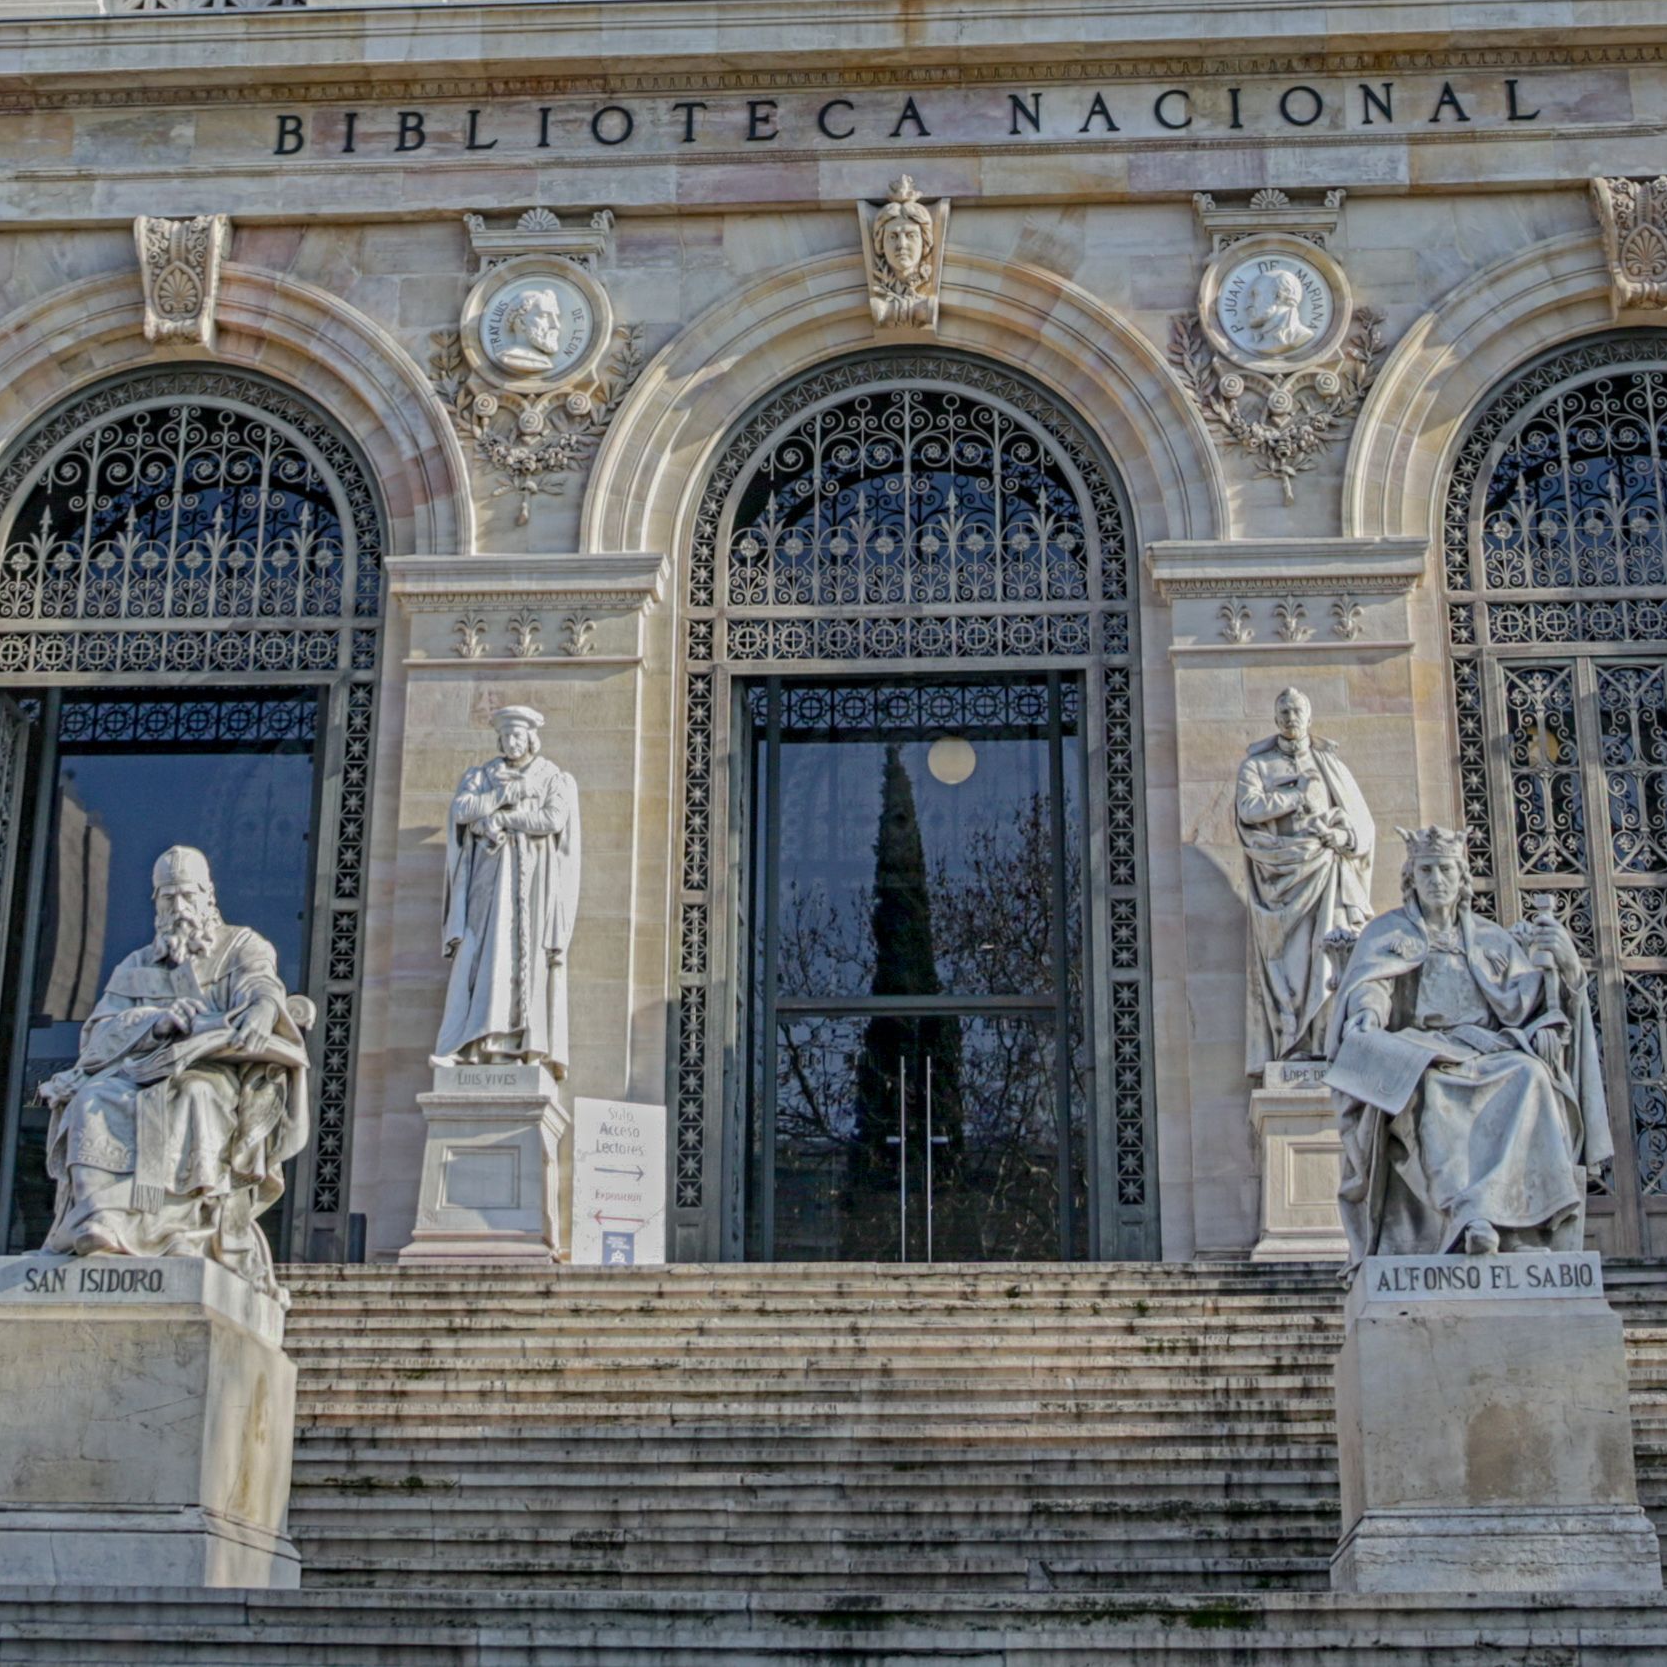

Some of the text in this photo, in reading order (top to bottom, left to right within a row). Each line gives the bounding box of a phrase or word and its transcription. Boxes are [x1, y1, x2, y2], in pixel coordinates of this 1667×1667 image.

[273, 79, 1541, 155] BIBLIOTECA NACIONAL
[1224, 275, 1246, 315] JUAN
[1295, 268, 1325, 330] MARIANA
[490, 300, 509, 325] LUIS
[571, 308, 584, 323] DE
[564, 329, 585, 358] LEON
[457, 1071, 517, 1086] LUIS VIVES
[1283, 1069, 1310, 1082] LOPE
[599, 1122, 640, 1138] Acceso
[596, 1138, 645, 1157] Lectores
[24, 1267, 66, 1294] SAN
[1377, 1265, 1481, 1292] ALFONSO
